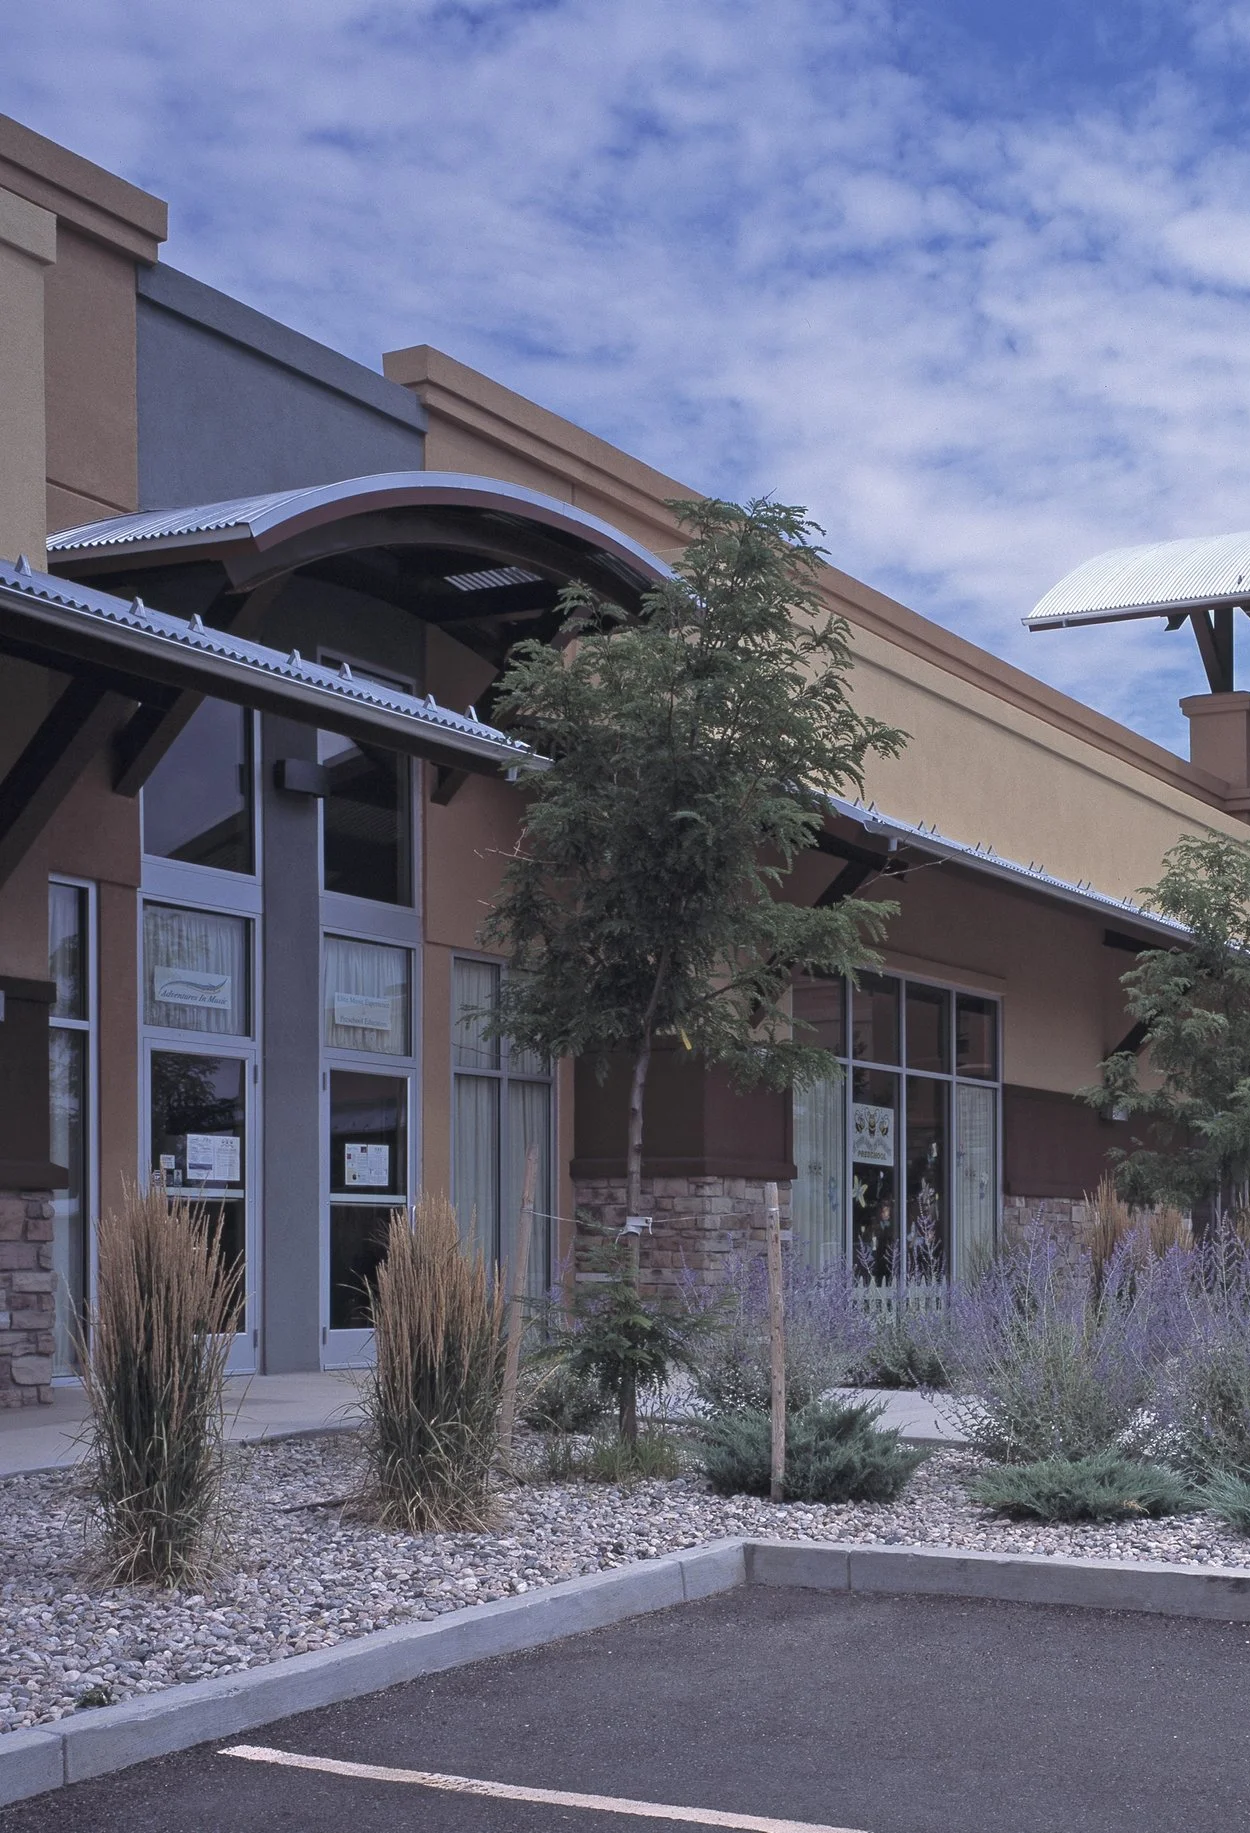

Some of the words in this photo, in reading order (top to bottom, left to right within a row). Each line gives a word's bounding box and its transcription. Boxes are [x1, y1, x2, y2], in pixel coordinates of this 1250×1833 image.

[160, 990, 198, 1001] Adventures
[199, 994, 206, 1002] In
[207, 995, 228, 1005] Music
[857, 1150, 887, 1160] PRESCHOOL
